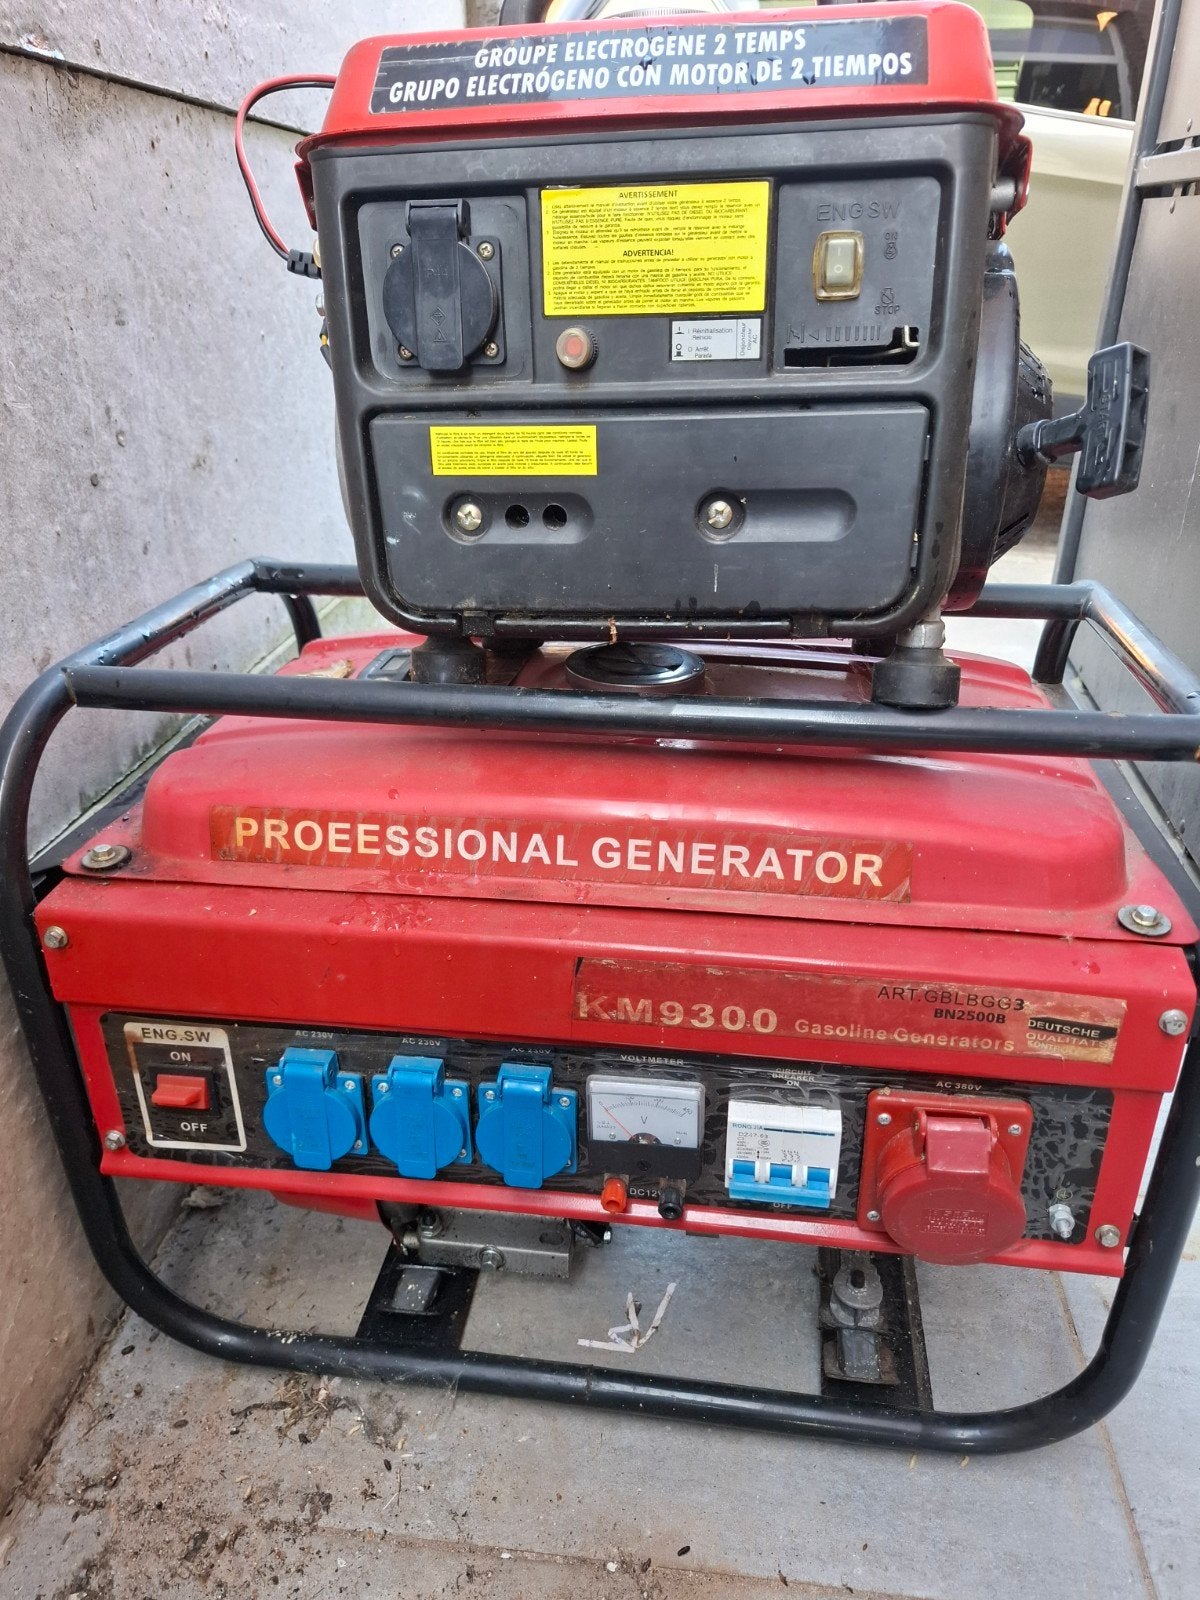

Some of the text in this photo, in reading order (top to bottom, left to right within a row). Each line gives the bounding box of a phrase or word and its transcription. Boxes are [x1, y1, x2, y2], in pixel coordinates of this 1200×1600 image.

[474, 28, 807, 69] GROUPE ELECTROGENE 2 TEMPS
[389, 52, 913, 104] GRUPO ELECTRÓGENO CON MOTOR DE 2 TIEMPOS
[619, 190, 679, 199] AVERTISSEMENT
[234, 816, 884, 887] PROEESSIONAL GENERATOR
[934, 1008, 1006, 1024] BN2500B
[1028, 1019, 1100, 1038] DEUTSCHE
[141, 1027, 211, 1043] ENG.SW
[311, 1031, 334, 1039] 230V
[794, 1019, 1015, 1052] Gasoline Generators
[401, 1037, 441, 1047] AC 230V
[170, 1051, 191, 1062] ON
[620, 1054, 684, 1065] VOLTMETER
[936, 1081, 982, 1091] AC 380V
[640, 1115, 648, 1125] V
[180, 1122, 208, 1133] OFF
